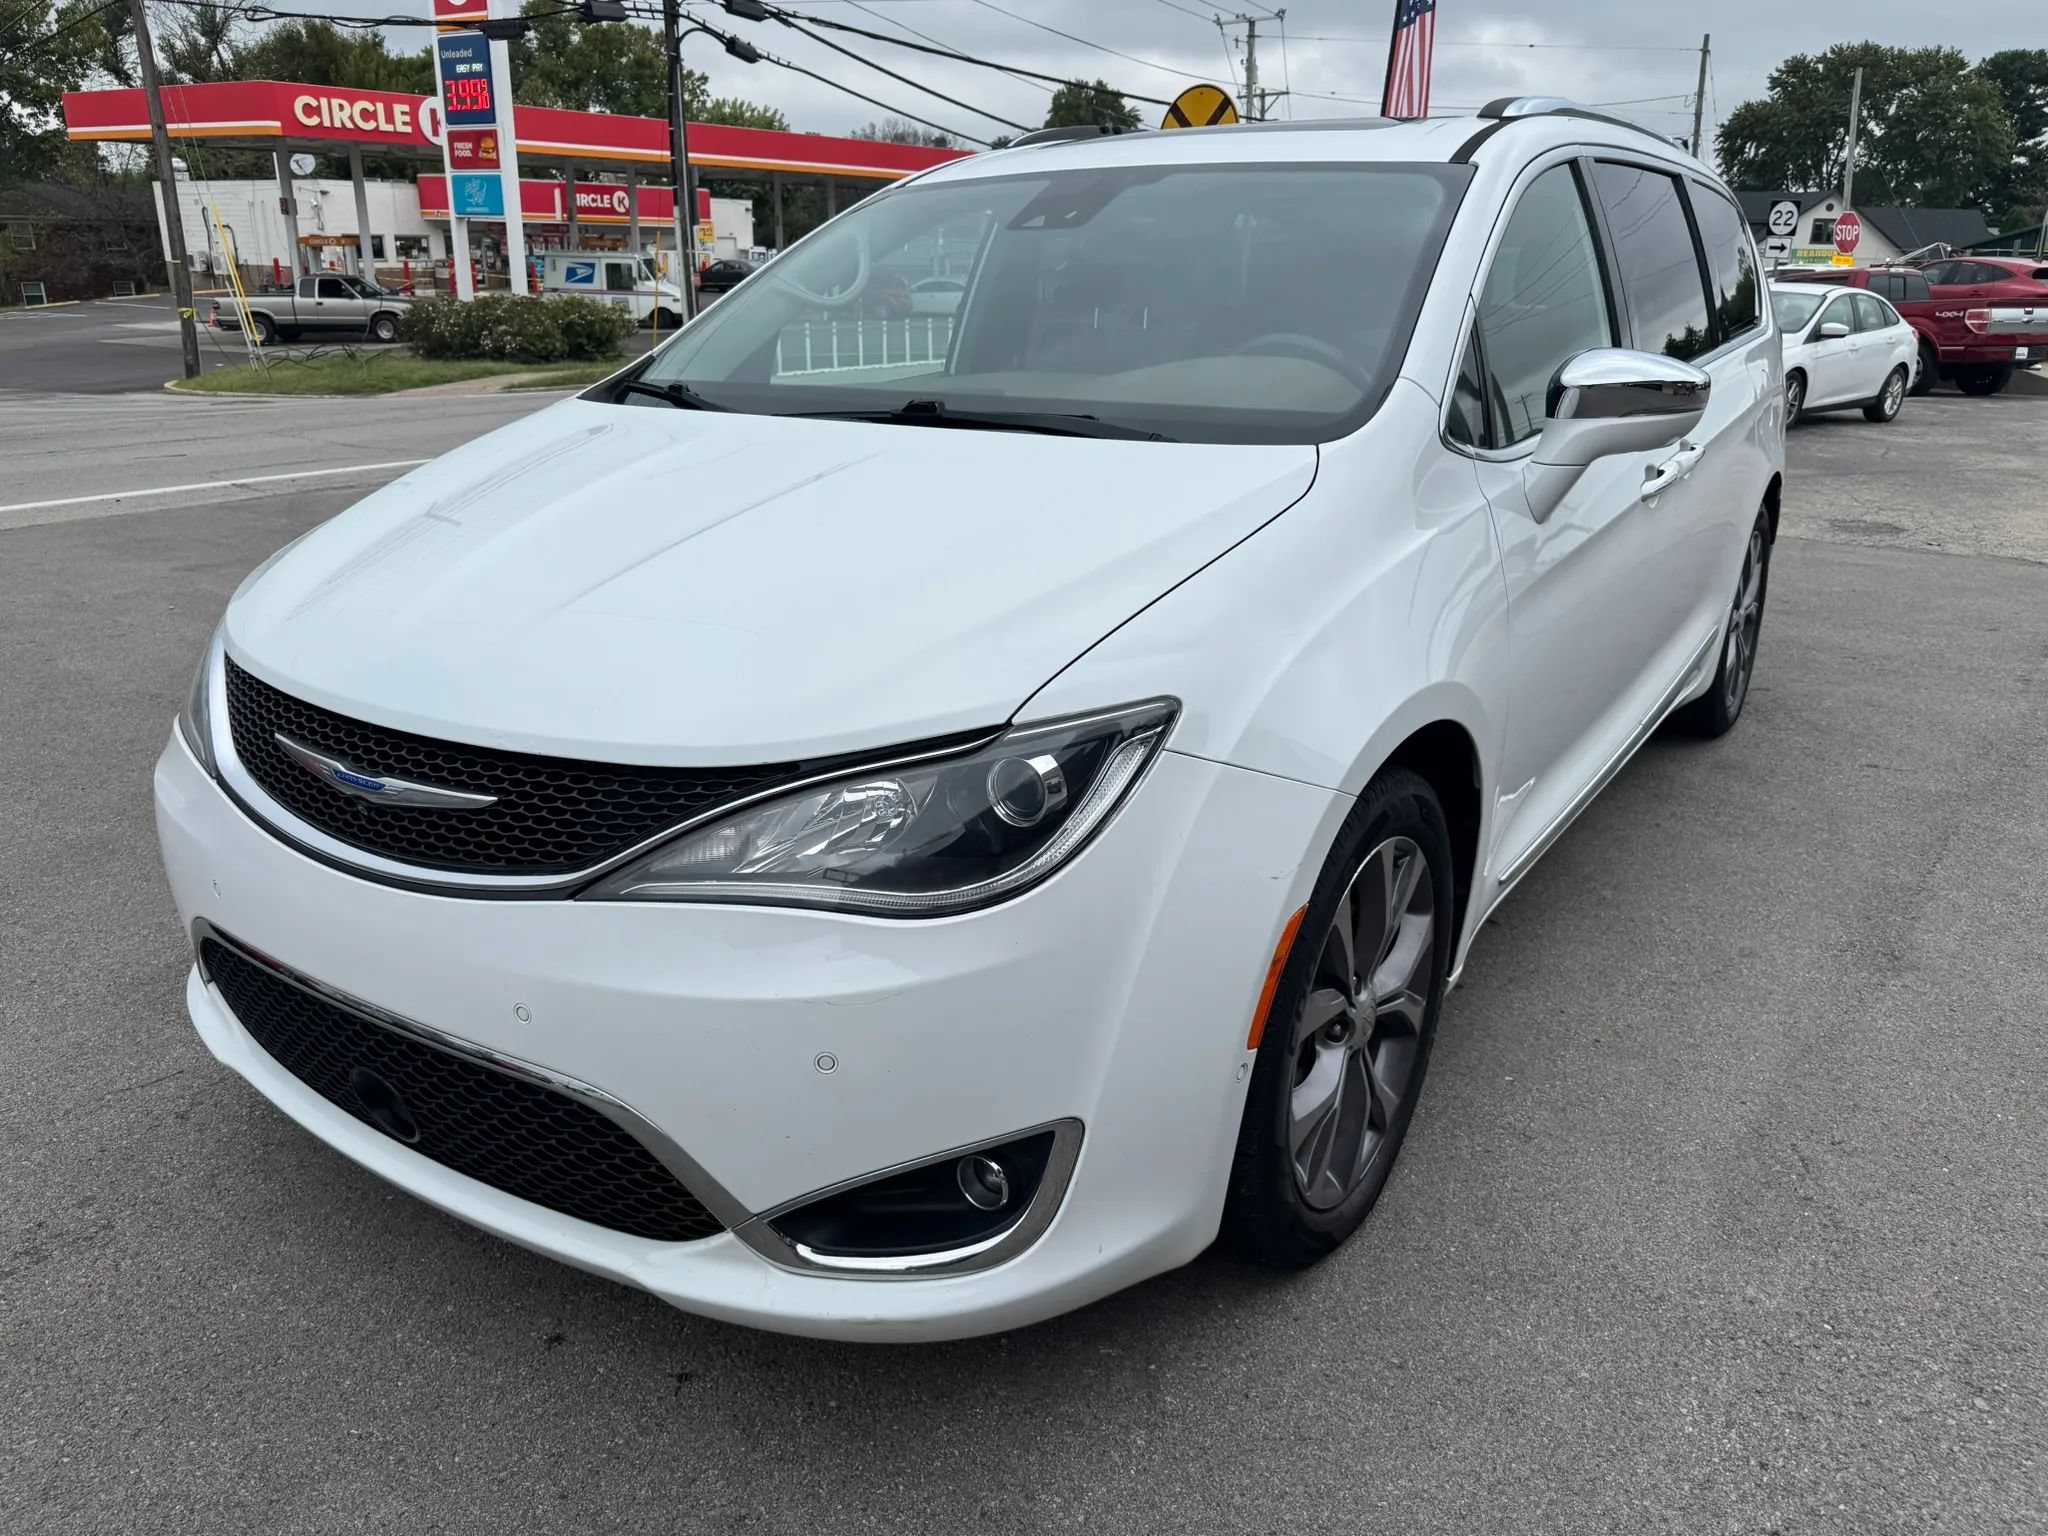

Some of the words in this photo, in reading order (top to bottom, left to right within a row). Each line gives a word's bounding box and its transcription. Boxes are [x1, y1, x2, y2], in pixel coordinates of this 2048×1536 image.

[441, 48, 472, 59] Unleaded
[456, 63, 470, 73] EASY
[472, 63, 483, 72] PAY
[294, 95, 412, 133] CIRCLE
[576, 193, 611, 208] IRCLE
[1772, 210, 1794, 226] 22
[1835, 224, 1859, 241] STOP
